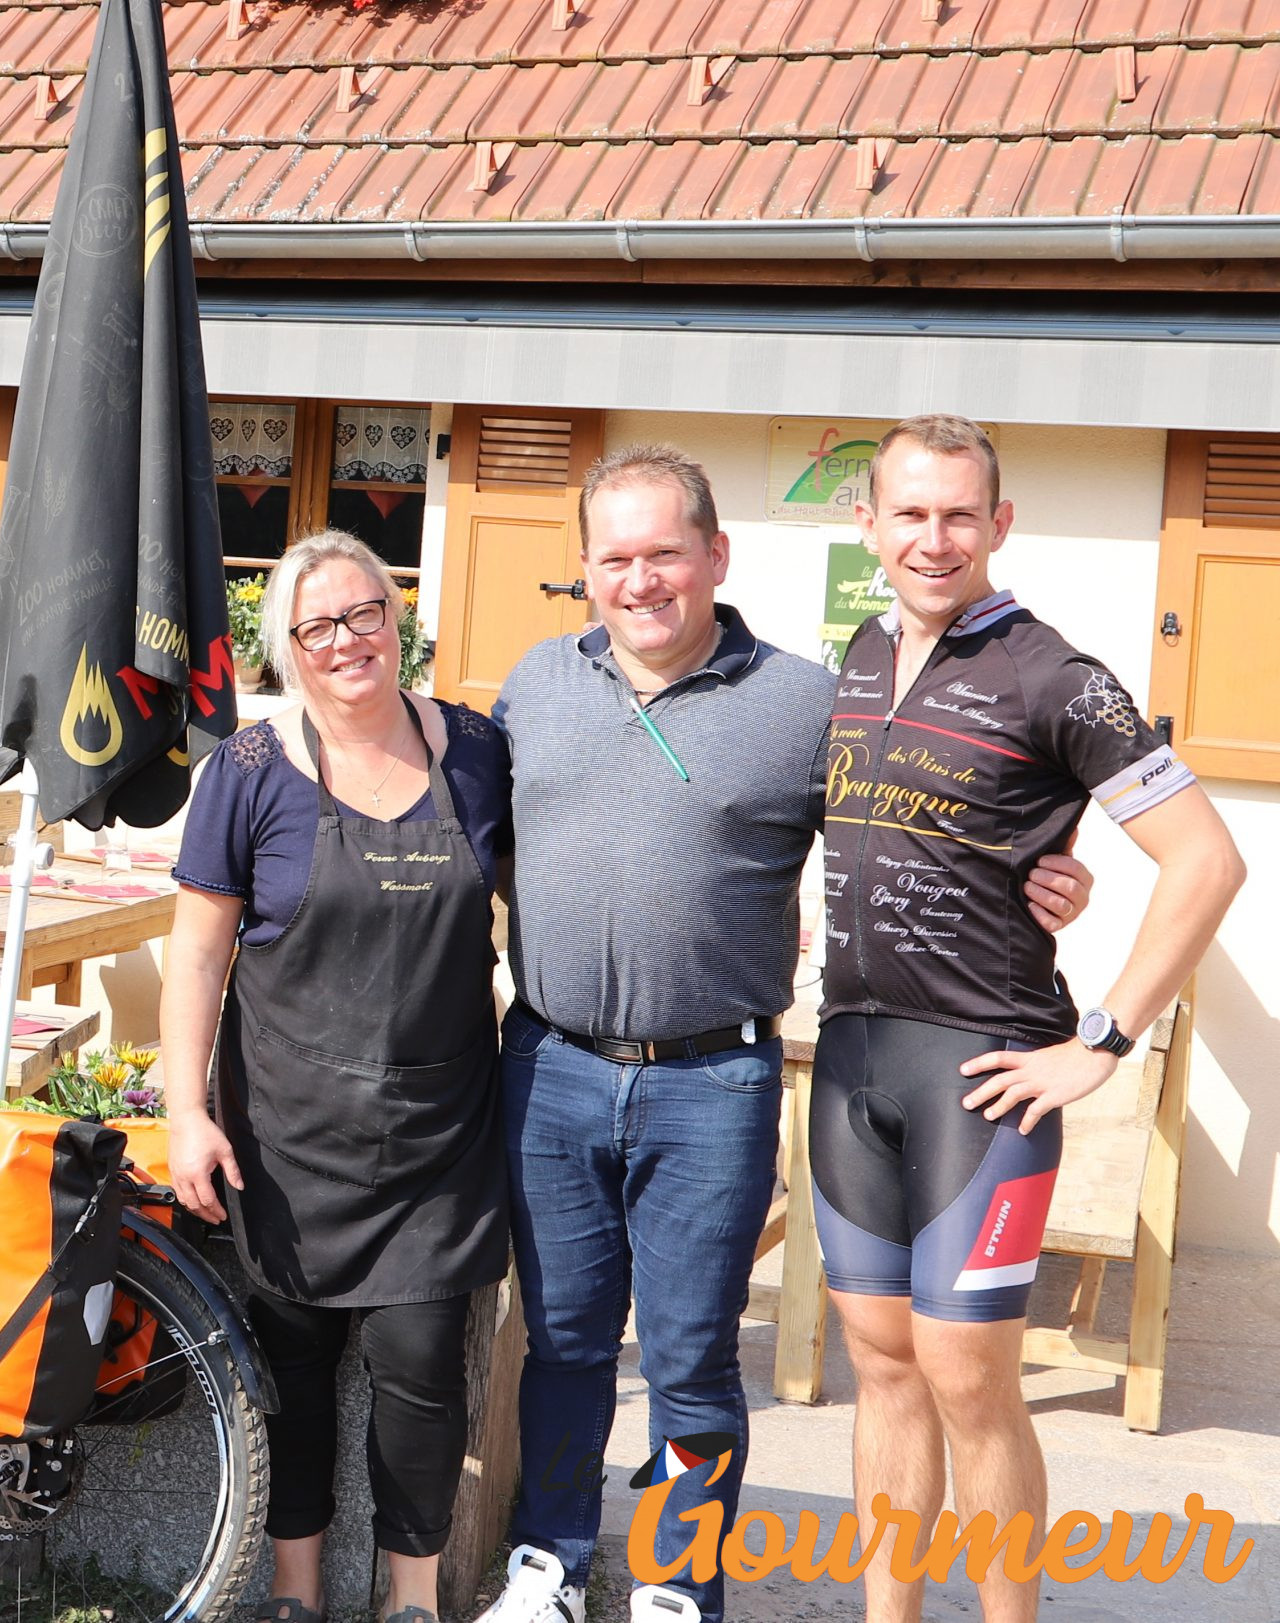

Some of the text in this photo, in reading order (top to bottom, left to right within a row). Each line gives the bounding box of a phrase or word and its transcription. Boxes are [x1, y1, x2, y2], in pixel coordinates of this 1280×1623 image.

[887, 746, 907, 765] des
[908, 747, 951, 776] Vins
[952, 767, 977, 785] de
[825, 743, 969, 822] Bourgogne
[363, 851, 451, 865] Ferme Auberge
[870, 884, 911, 912] Givry
[896, 872, 969, 903] Vougeot
